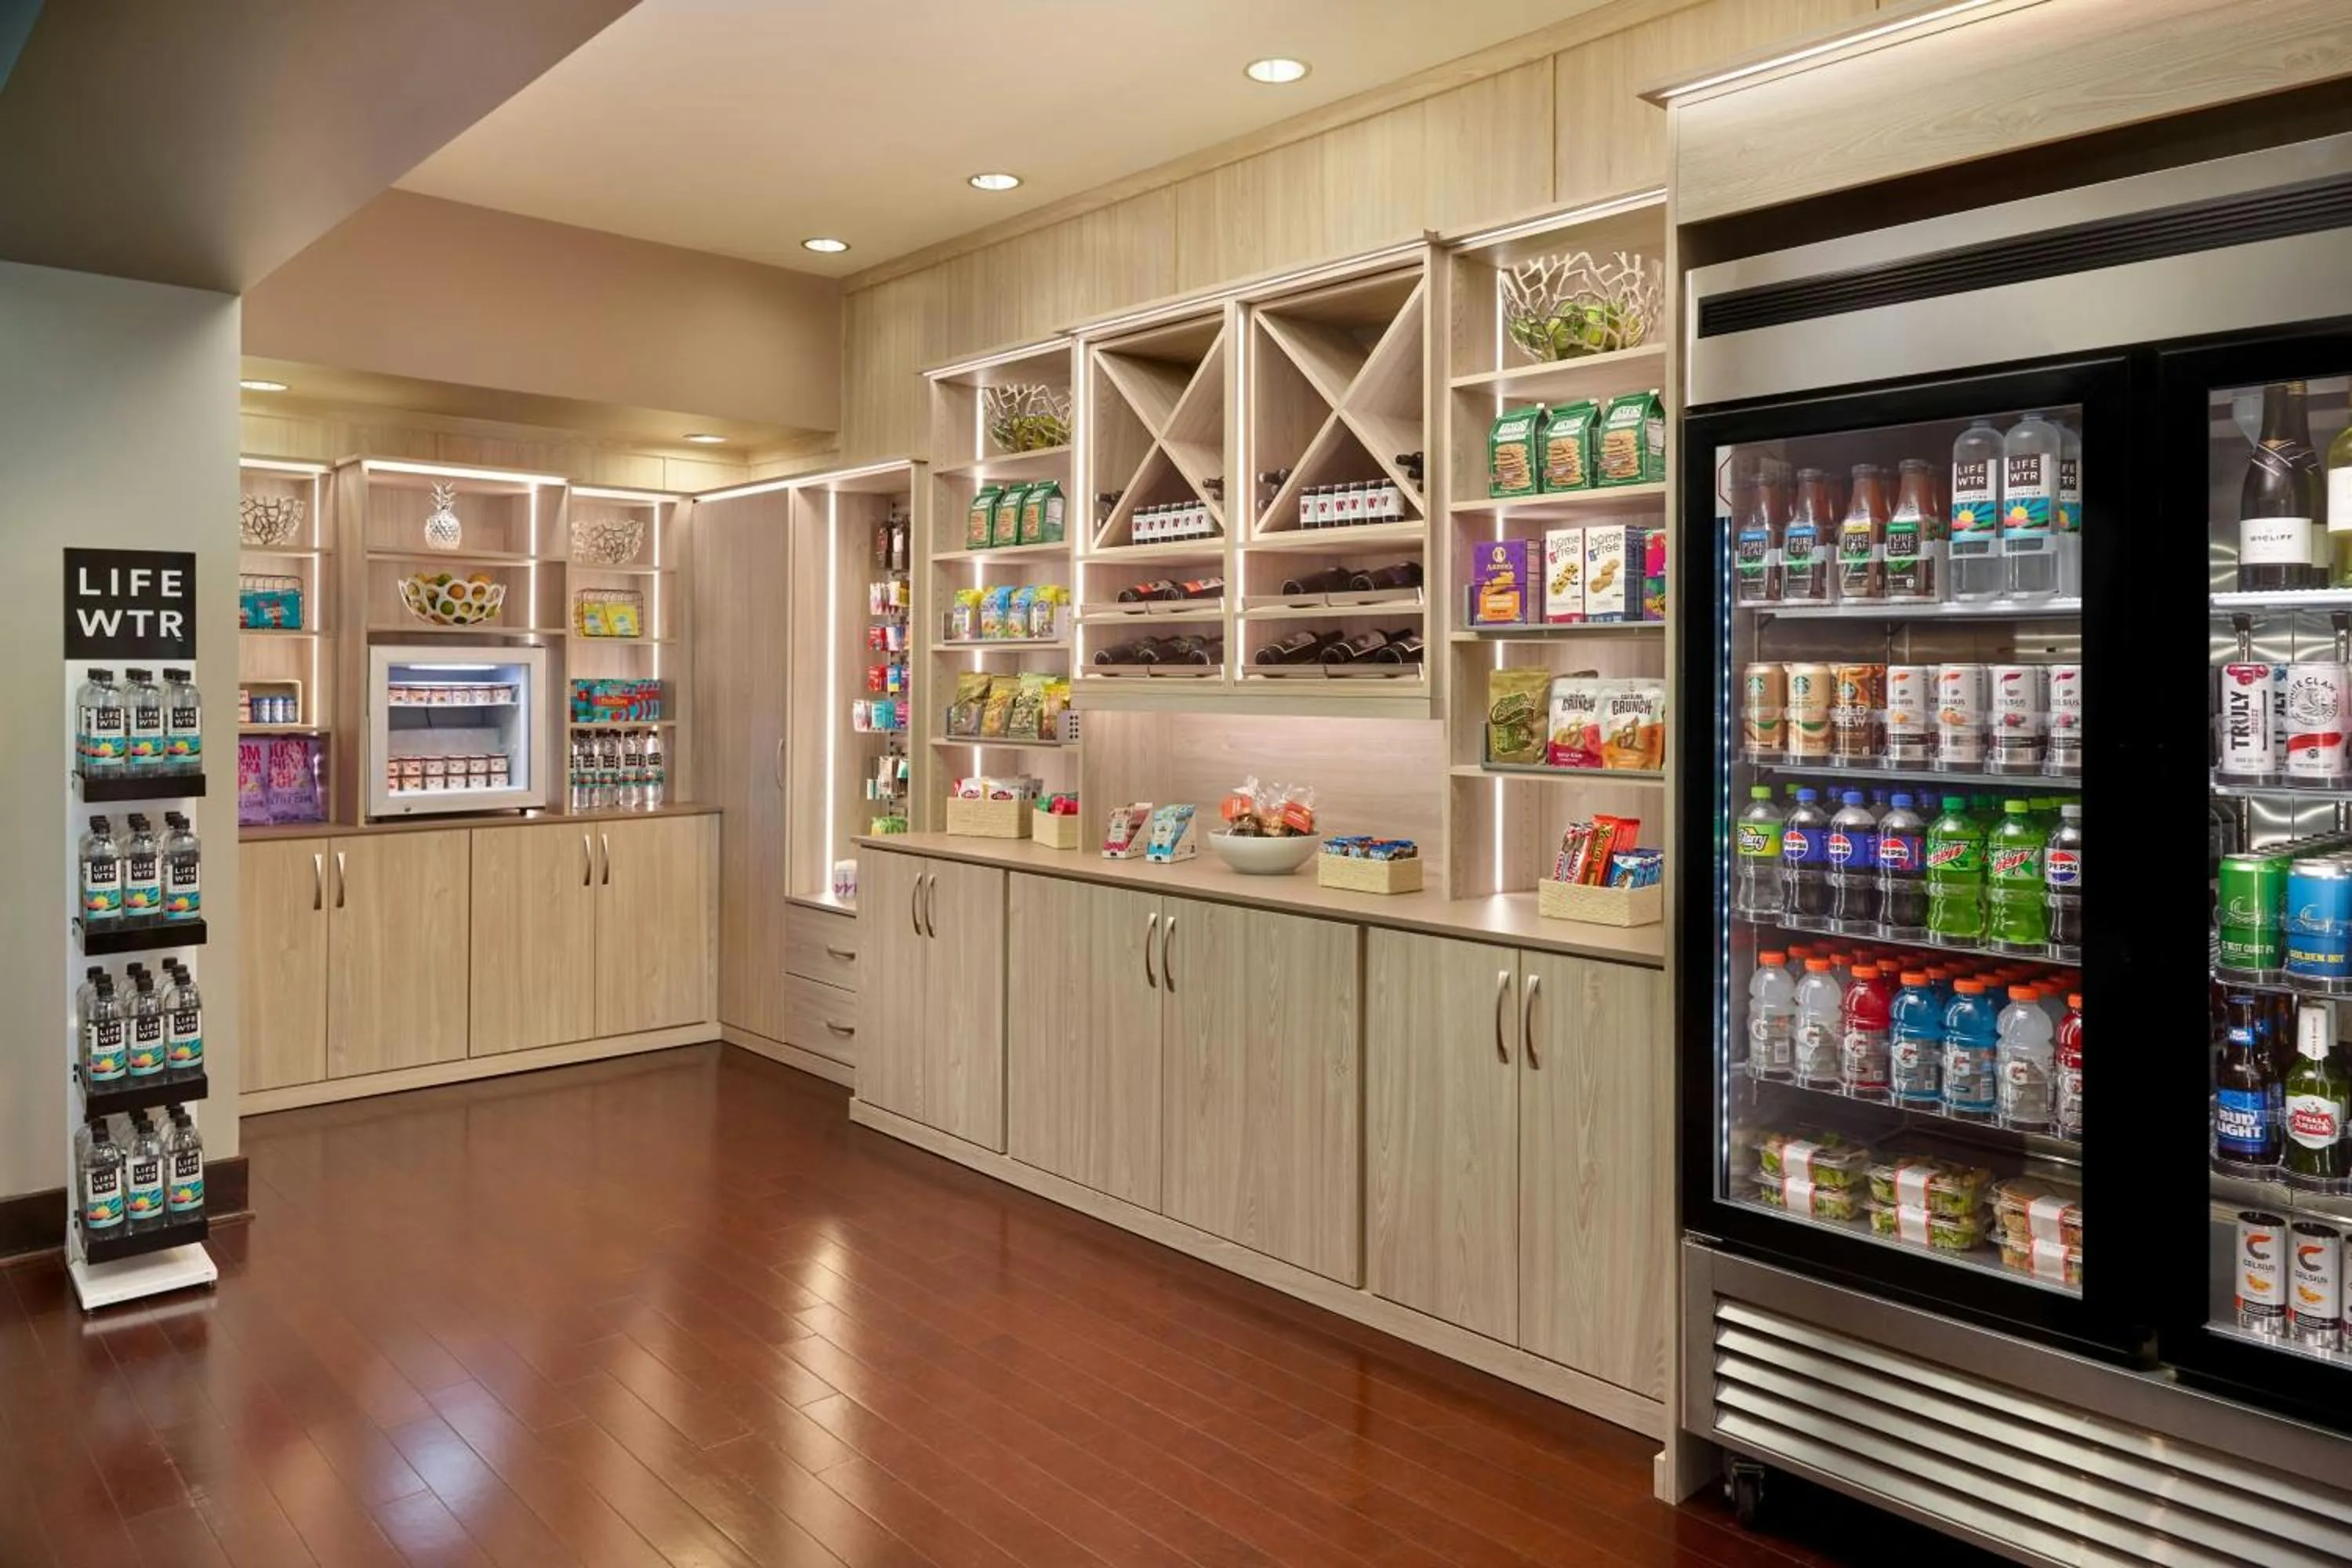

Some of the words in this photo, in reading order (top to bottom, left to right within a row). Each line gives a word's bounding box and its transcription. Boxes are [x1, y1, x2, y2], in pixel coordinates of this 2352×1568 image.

[1958, 463, 1985, 474] LIFE
[2010, 459, 2038, 470] LIFE
[2062, 463, 2076, 473] FE
[1958, 476, 1985, 486] WTR
[2010, 471, 2038, 482] WTR
[2063, 476, 2076, 485] TR
[79, 567, 183, 597] LIFE
[76, 609, 183, 638] WTR
[1612, 699, 1653, 715] CRUNCH
[1837, 705, 1867, 716] OLD
[2230, 691, 2249, 750] TRULY
[94, 872, 116, 880] WTR
[100, 1027, 120, 1036] LIFE
[139, 1022, 159, 1031] LIFE
[100, 1035, 121, 1044] WTR
[139, 1030, 159, 1039] WTR
[1893, 1043, 1919, 1068] G
[2007, 1061, 2028, 1085] G
[2219, 1109, 2256, 1127] BUD
[2216, 1121, 2263, 1138] LIGHT
[178, 1156, 198, 1167] LIFE
[136, 1165, 156, 1174] LIFE
[178, 1165, 199, 1174] WTR
[93, 1174, 115, 1183] LIFE
[136, 1173, 156, 1181] WTR
[93, 1182, 115, 1191] WTR
